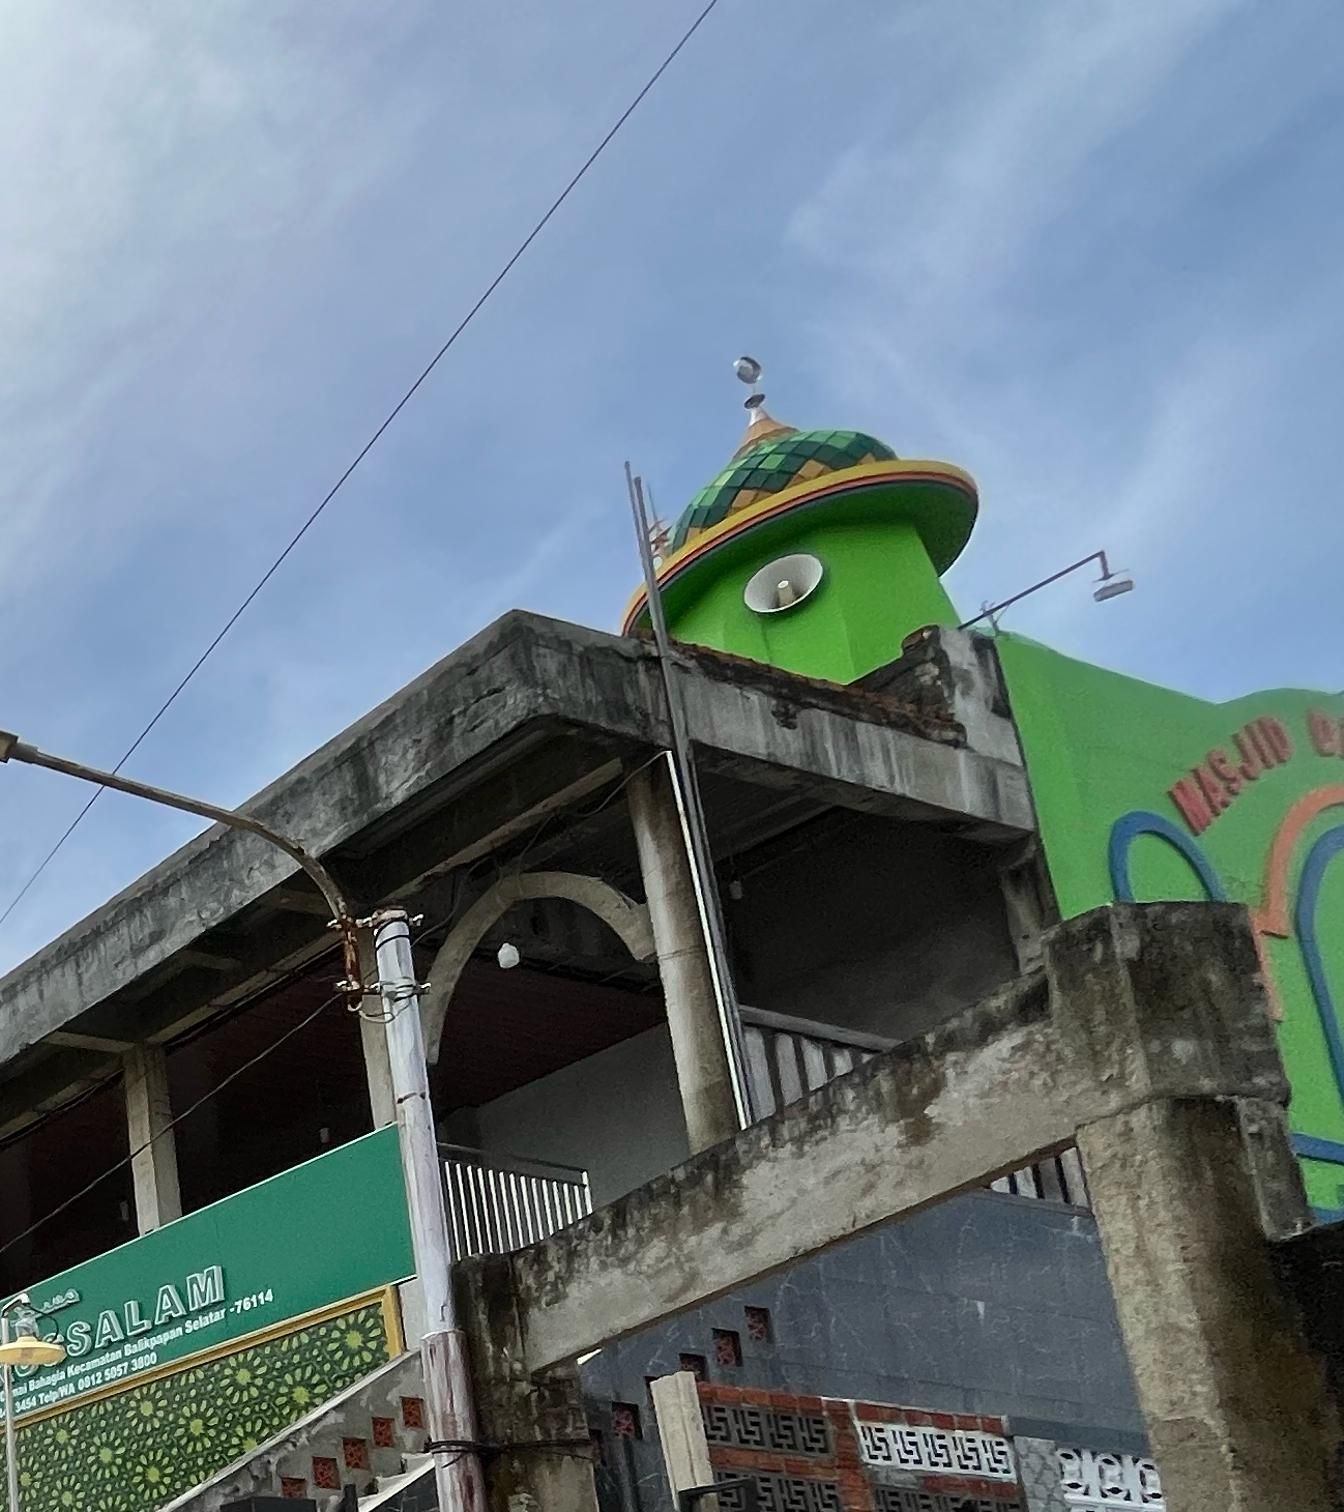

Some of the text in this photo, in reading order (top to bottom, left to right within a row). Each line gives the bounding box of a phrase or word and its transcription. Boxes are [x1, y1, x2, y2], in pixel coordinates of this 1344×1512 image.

[1168, 705, 1344, 837] MASJID D
[28, 1369, 65, 1391] Bahagia
[66, 1350, 122, 1377] Kecamatan
[123, 1326, 183, 1356] Balikpapan
[77, 1371, 103, 1390] 0812
[103, 1361, 129, 1381] 5057
